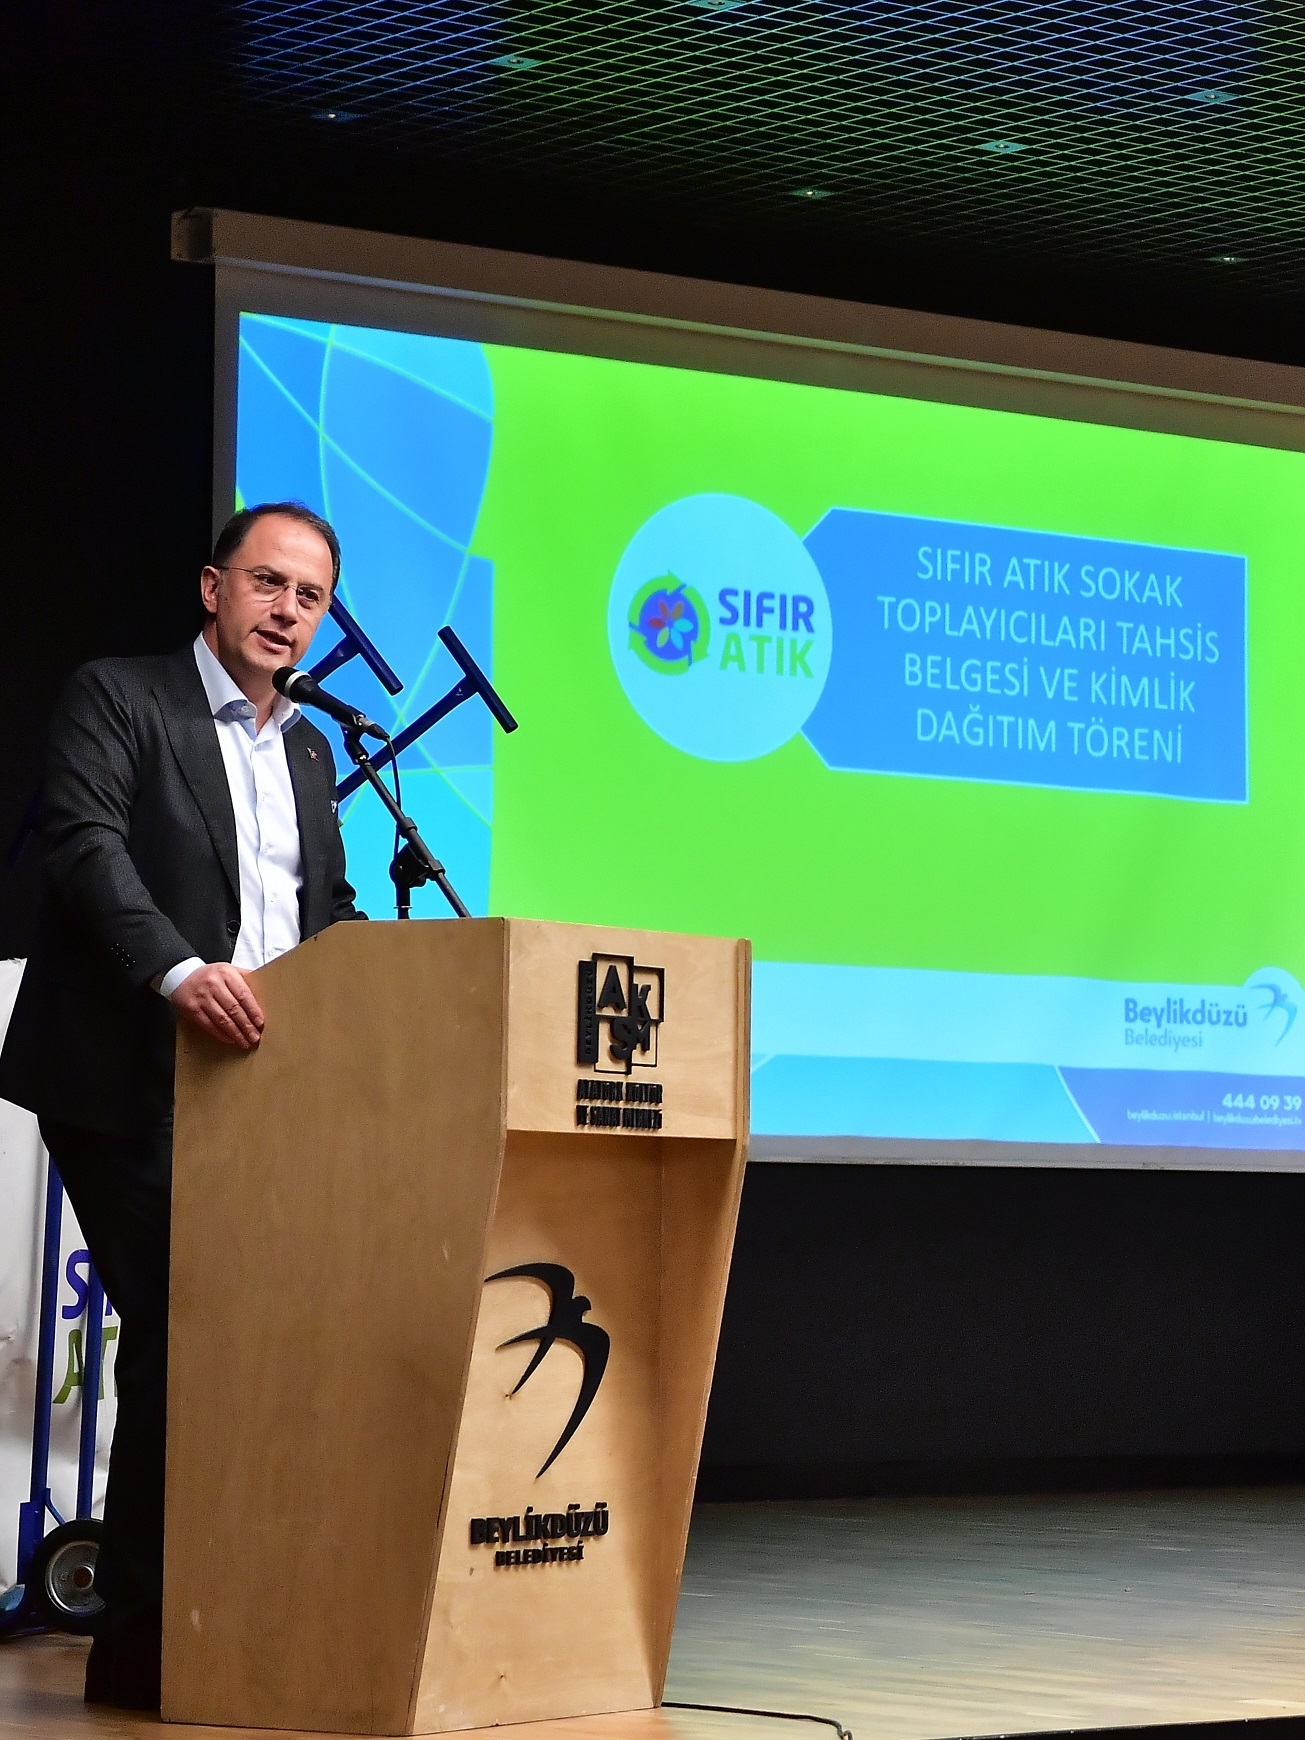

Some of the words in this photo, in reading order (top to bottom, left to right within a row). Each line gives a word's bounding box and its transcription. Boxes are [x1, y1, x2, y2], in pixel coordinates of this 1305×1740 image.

[917, 546, 992, 586] SIFIR
[1003, 556, 1070, 595] ATIK
[1079, 565, 1183, 607] SOKAK
[718, 588, 815, 633] SIFIR
[877, 595, 1105, 651] TOPLAYICILARI
[1116, 621, 1220, 664] TAHSİS
[718, 633, 815, 679] ATIK
[904, 653, 1029, 697] BELGESİ
[1039, 665, 1079, 701] VE
[1090, 666, 1196, 713] KİMLİK
[916, 704, 1056, 753] DAĞITIM
[1067, 717, 1183, 764] TÖRENİ
[1124, 997, 1248, 1029] Beylikdüzü
[1124, 1028, 1203, 1051] Belediyesi
[1221, 1092, 1256, 1110] 444
[1260, 1095, 1280, 1110] 09
[1283, 1095, 1303, 1111] 39
[471, 1502, 609, 1545] BEYLİKDÜZÜ
[496, 1540, 585, 1567] BELEDİYESİ
